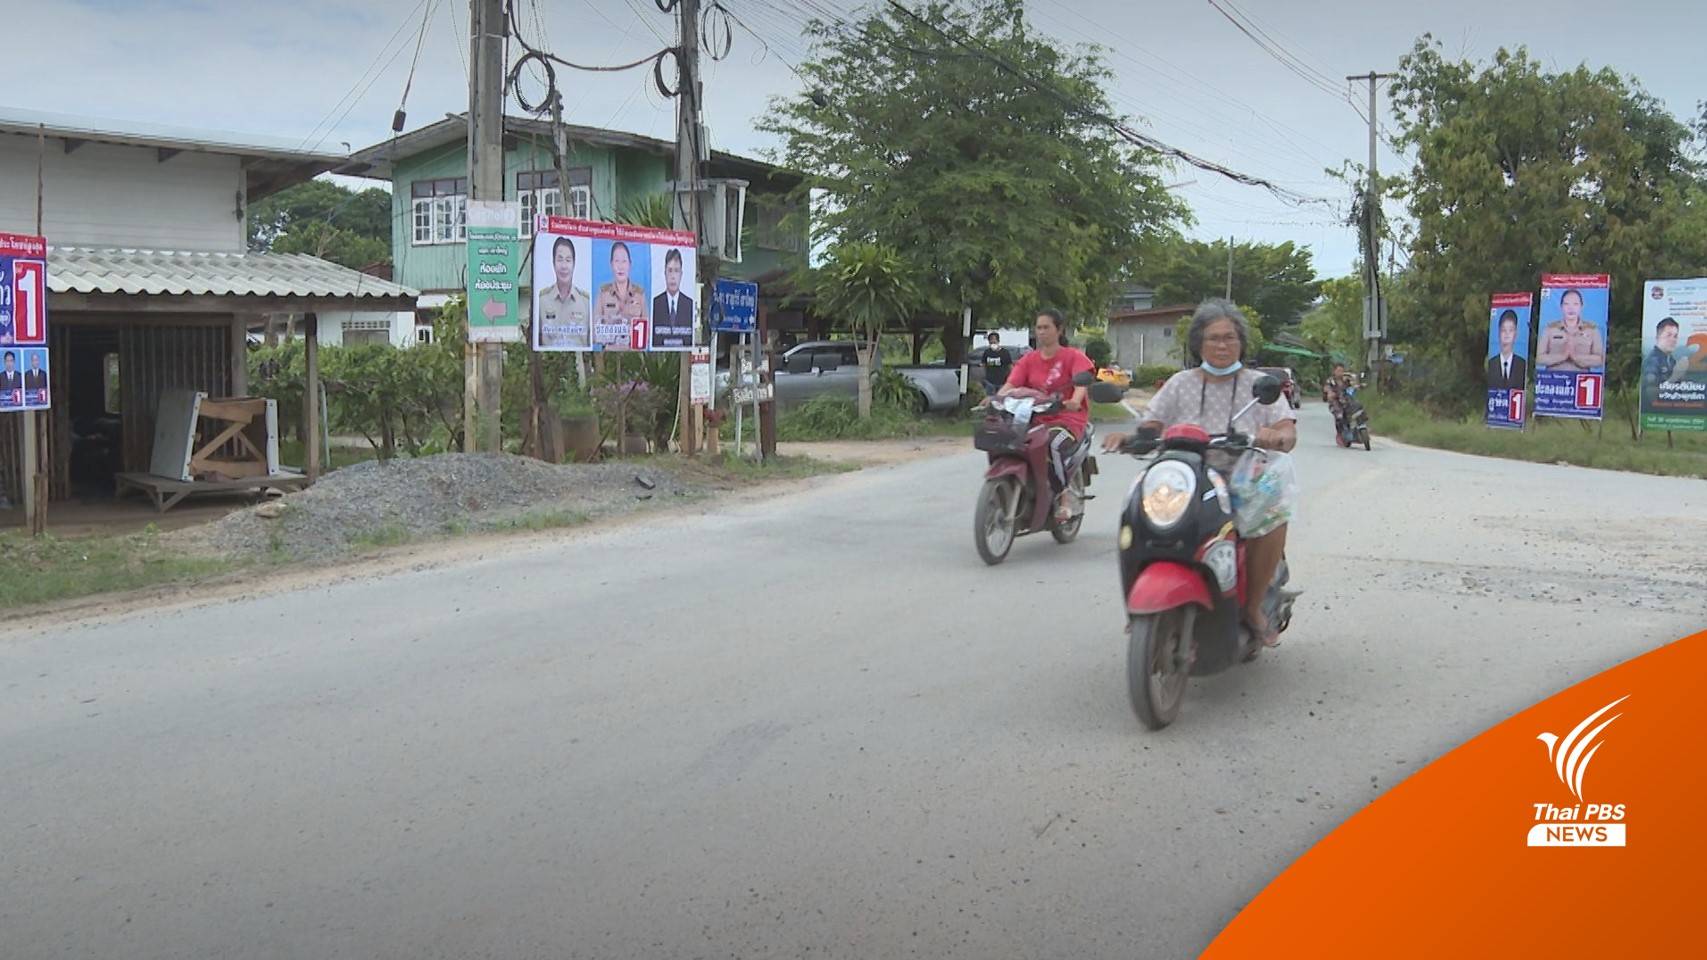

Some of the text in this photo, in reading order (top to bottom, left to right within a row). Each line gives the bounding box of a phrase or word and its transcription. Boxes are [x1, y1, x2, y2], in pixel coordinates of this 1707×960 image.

[480, 262, 507, 273] ห้องพัก
[475, 279, 512, 292] ห้องประชุม
[18, 269, 37, 337] 1
[634, 322, 645, 349] 1
[1580, 377, 1595, 405] 1
[1512, 393, 1521, 420] 1
